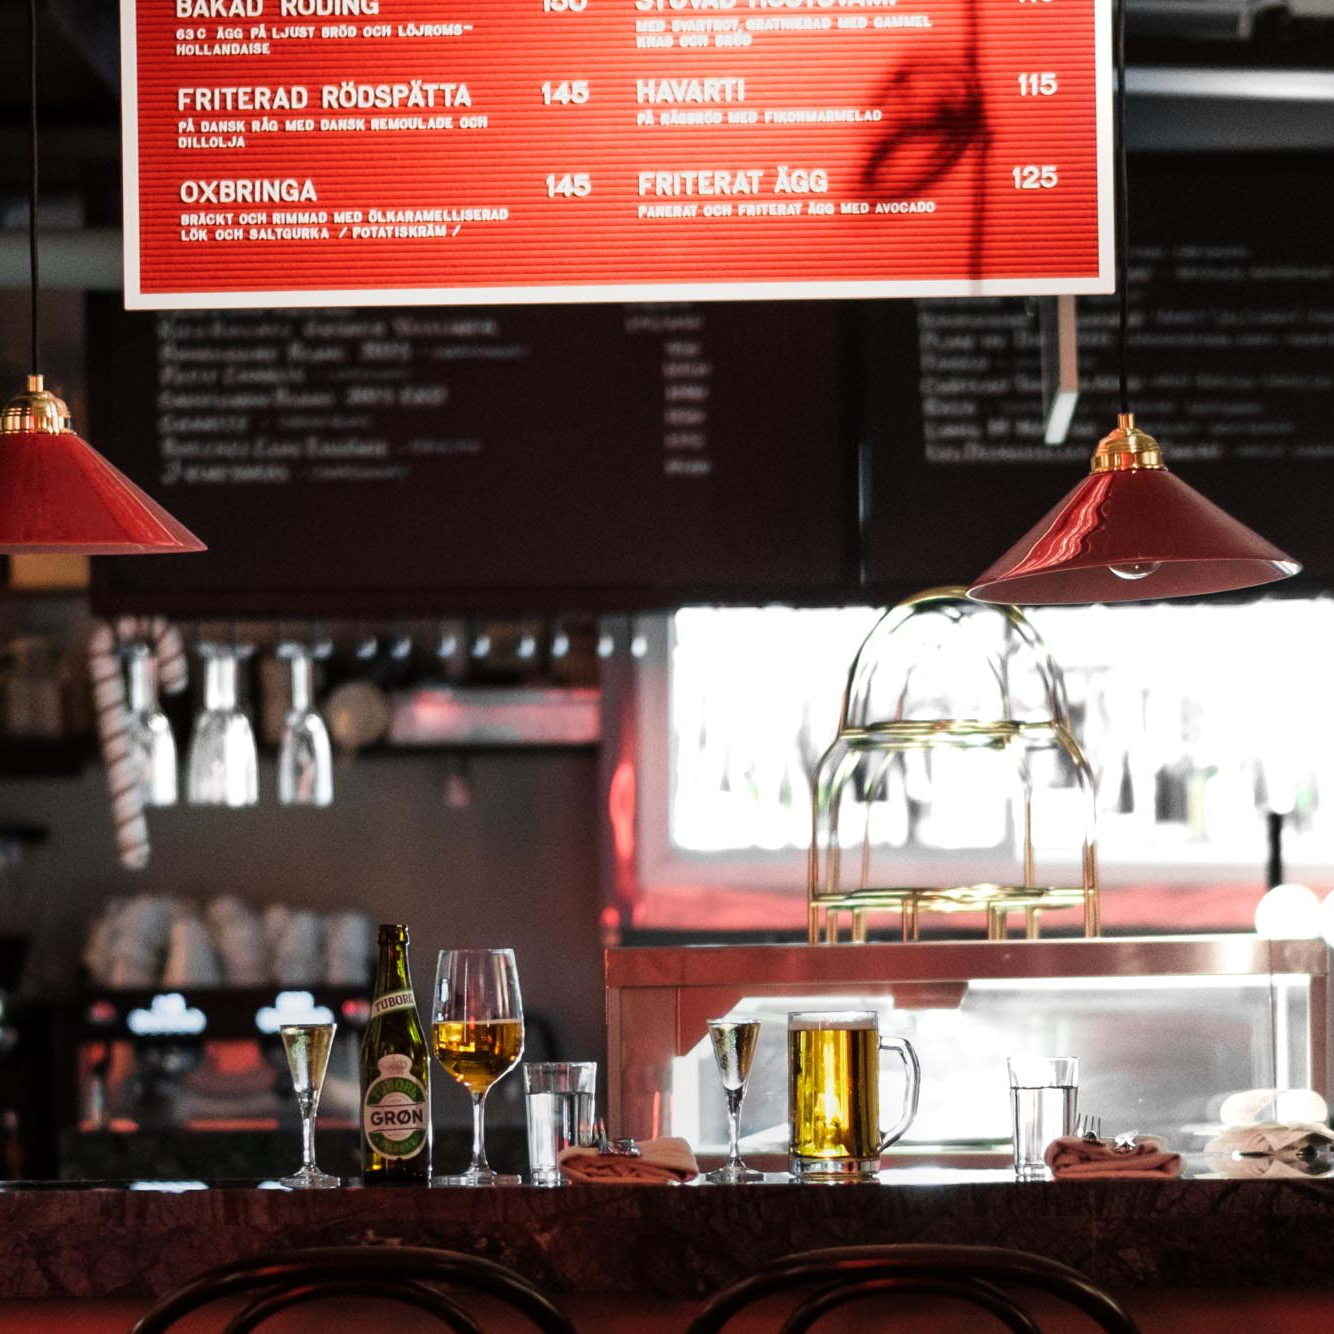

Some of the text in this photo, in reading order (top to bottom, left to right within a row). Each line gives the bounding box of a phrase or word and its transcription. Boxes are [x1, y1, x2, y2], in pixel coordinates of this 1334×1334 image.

[177, 0, 263, 17] BAKAD
[176, 29, 194, 39] 63
[217, 27, 243, 39] ÄGG
[251, 24, 266, 39] PÅ
[272, 26, 315, 38] LJUST
[322, 24, 357, 38] BRÖD
[363, 25, 391, 37] OCH
[636, 20, 665, 32] MED
[177, 43, 270, 55] HOLLANDAISE
[680, 34, 708, 47] OCH
[542, 80, 590, 105] 145
[637, 77, 745, 104] HAVARTI
[1019, 72, 1057, 96] 115
[179, 80, 471, 110] FRITERAD RÖDSPÄTTA
[179, 115, 488, 133] PÅ DANSK RÅG MED DANSK REMOULADE OCH
[637, 110, 654, 125] PÅ
[727, 109, 759, 123] MED
[179, 136, 245, 147] DILLOLJA
[547, 173, 592, 197] 145
[639, 165, 828, 196] FRITERAT ÄGG
[1013, 166, 1057, 188] 125
[181, 179, 317, 203] OXBRINGA
[181, 208, 509, 225] BRÄCKT OCH RIMMAD MED ÖLKARAMELLISERAD
[639, 204, 698, 217] PANERAT
[703, 204, 732, 216] OCH
[738, 202, 802, 215] FRITERAT
[841, 203, 869, 213] MED
[876, 201, 935, 213] AVOCADO
[182, 228, 207, 240] LÖK
[216, 228, 243, 240] OCH
[250, 227, 329, 239] SALTGURKA
[353, 223, 447, 238] POTATISKRÄM
[370, 1108, 423, 1126] GRØN
